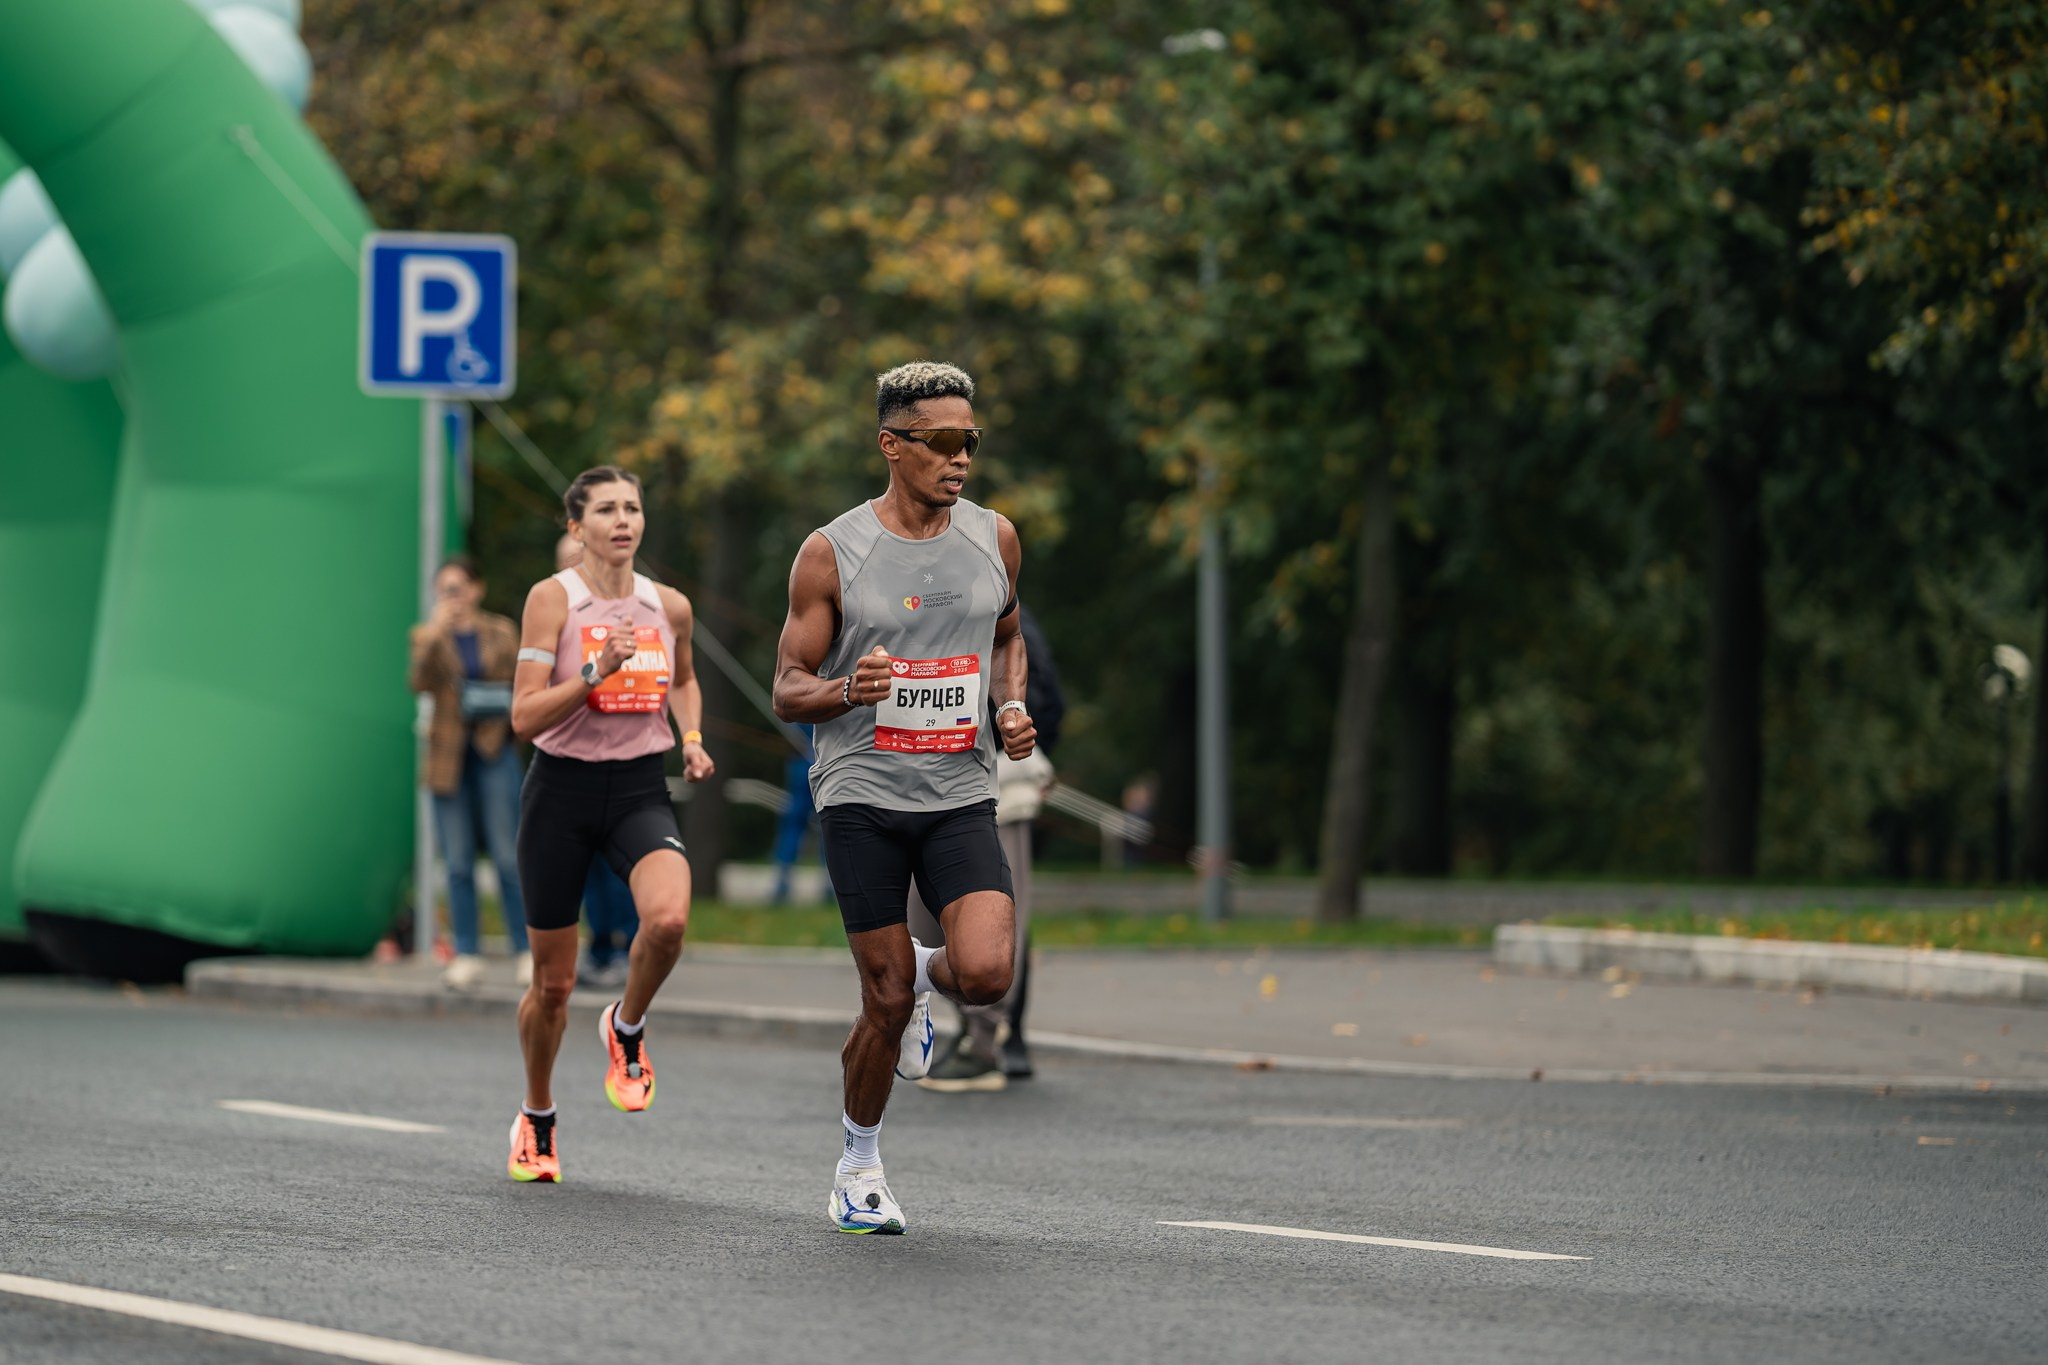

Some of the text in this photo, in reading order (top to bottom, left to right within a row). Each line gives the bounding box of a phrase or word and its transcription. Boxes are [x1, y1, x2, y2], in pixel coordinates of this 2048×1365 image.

[399, 254, 482, 377] P
[923, 593, 963, 603] МОСКОВСКИЙ
[923, 600, 953, 609] МАРАФОН
[897, 686, 965, 711] БУРЦЕВ
[925, 719, 936, 727] 29
